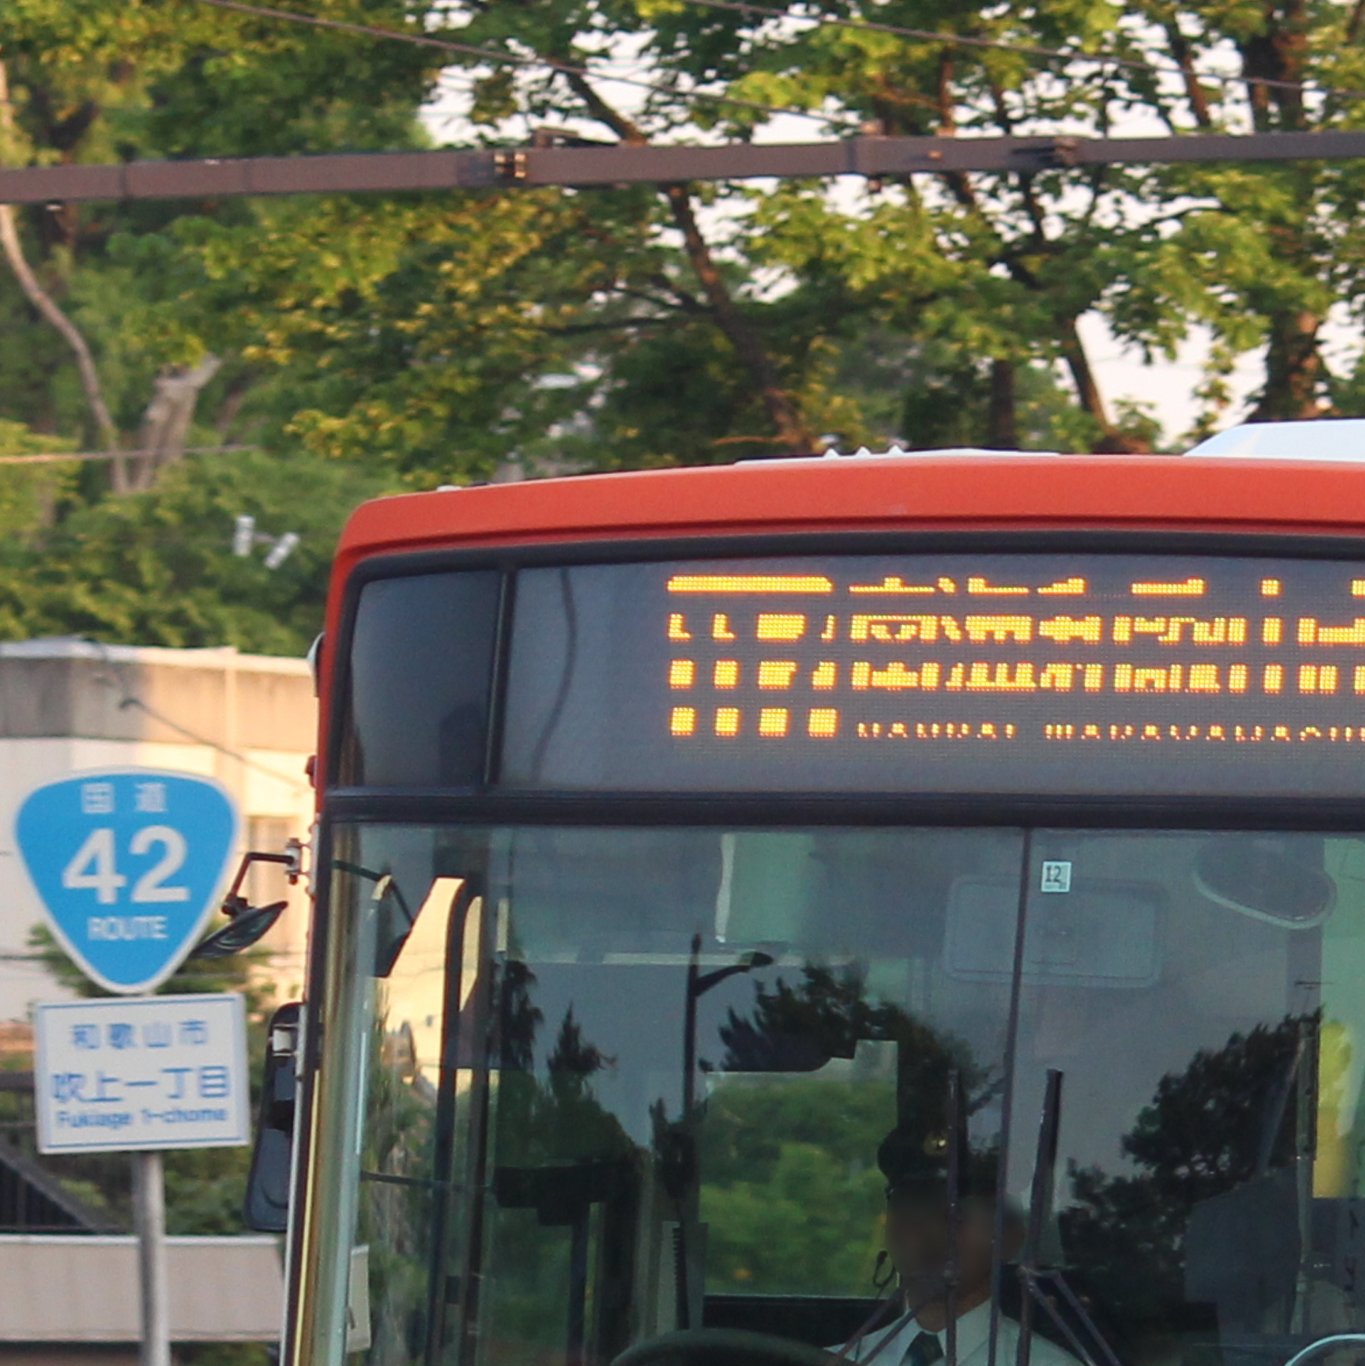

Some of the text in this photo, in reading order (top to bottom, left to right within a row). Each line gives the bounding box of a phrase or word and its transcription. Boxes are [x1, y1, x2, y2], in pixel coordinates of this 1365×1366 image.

[82, 782, 168, 814] 国道
[63, 825, 190, 904] 42
[88, 916, 168, 941] ROUTE
[70, 1020, 209, 1052] 和歌山市
[51, 1064, 230, 1104] 吹上一丁目
